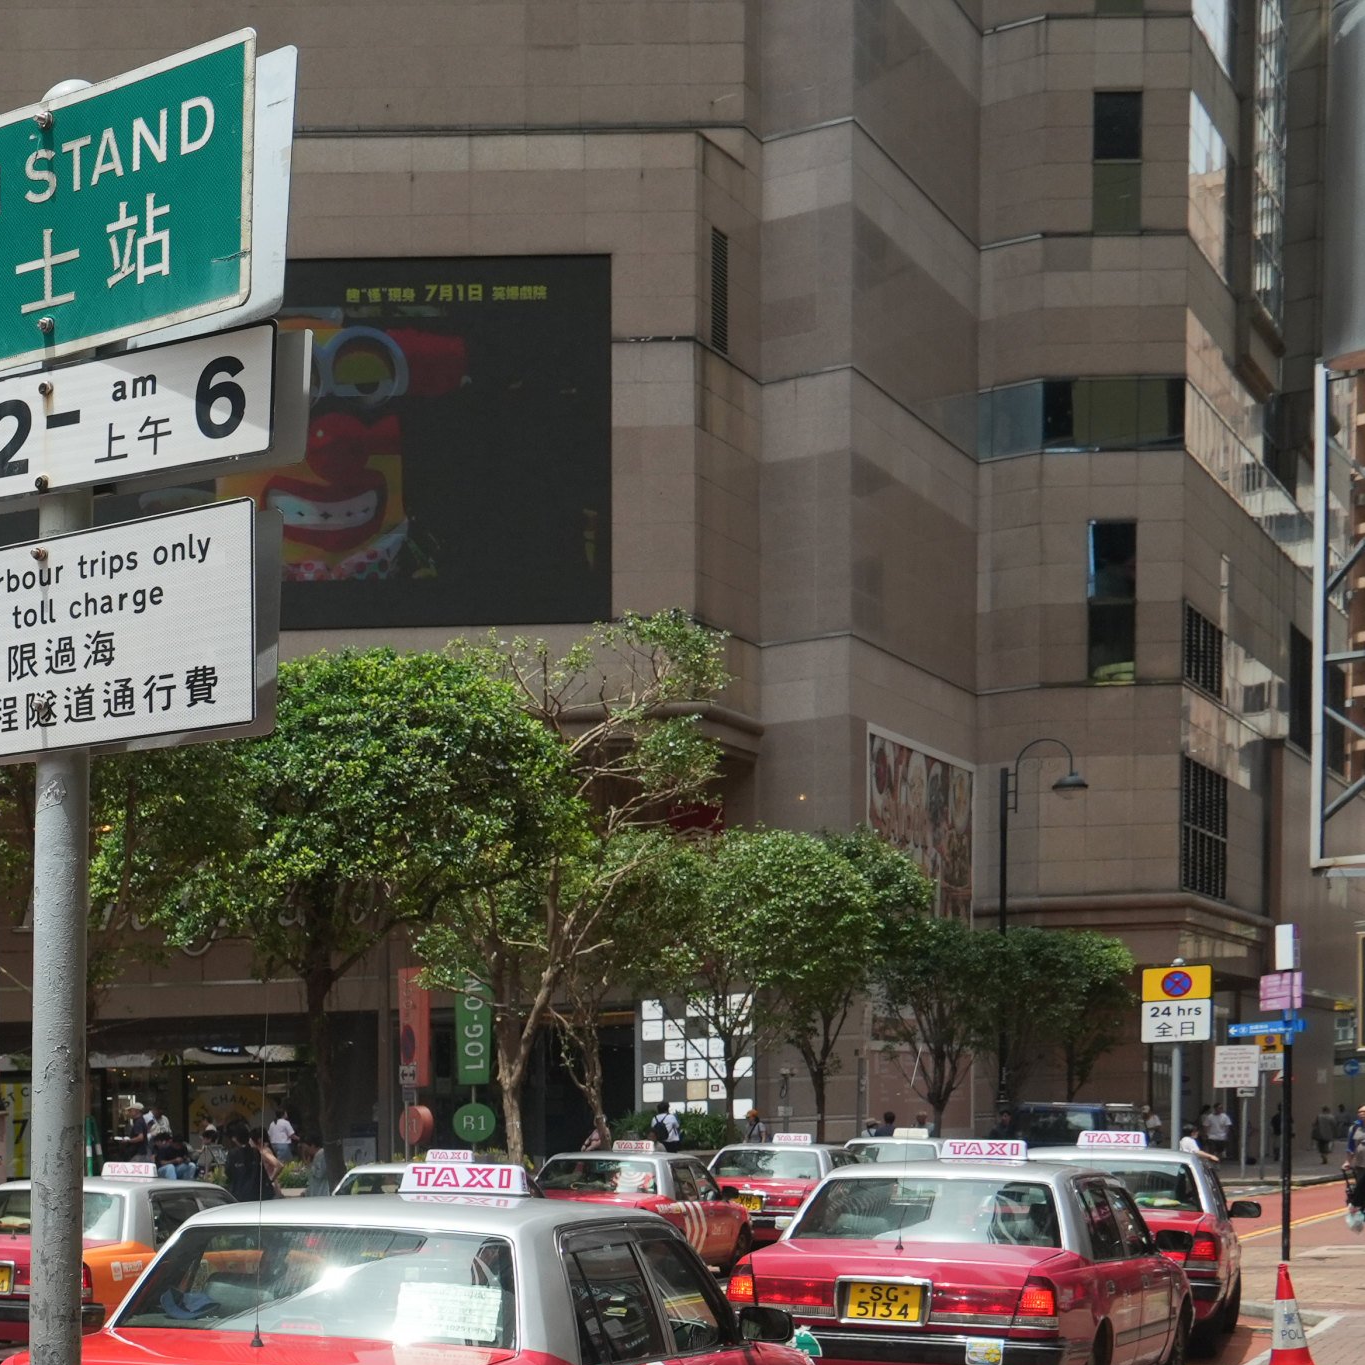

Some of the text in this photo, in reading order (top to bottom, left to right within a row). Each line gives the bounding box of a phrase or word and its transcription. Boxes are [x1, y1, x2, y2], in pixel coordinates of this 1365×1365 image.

[24, 95, 215, 203] STAND
[424, 284, 484, 302] 7月1日
[111, 374, 157, 402] am
[195, 355, 246, 440] 6
[94, 415, 172, 464] 上午
[77, 549, 138, 581] trips
[152, 533, 212, 566] only
[12, 598, 57, 630] toll
[69, 586, 165, 620] charge
[1150, 1003, 1203, 1018] 24 hrs
[463, 978, 485, 1071] LOG-ON
[1155, 1021, 1196, 1038] 全日
[463, 1115, 487, 1131] B1
[615, 1141, 652, 1150] TAXI
[776, 1134, 809, 1142] TAXI
[1085, 1132, 1142, 1144] TAXI
[430, 1150, 470, 1160] TAXI
[949, 1141, 1020, 1156] TAXI
[107, 1163, 151, 1175] TAXI
[412, 1166, 512, 1190] TAXI
[869, 1286, 899, 1302] SG
[856, 1301, 909, 1319] 5134
